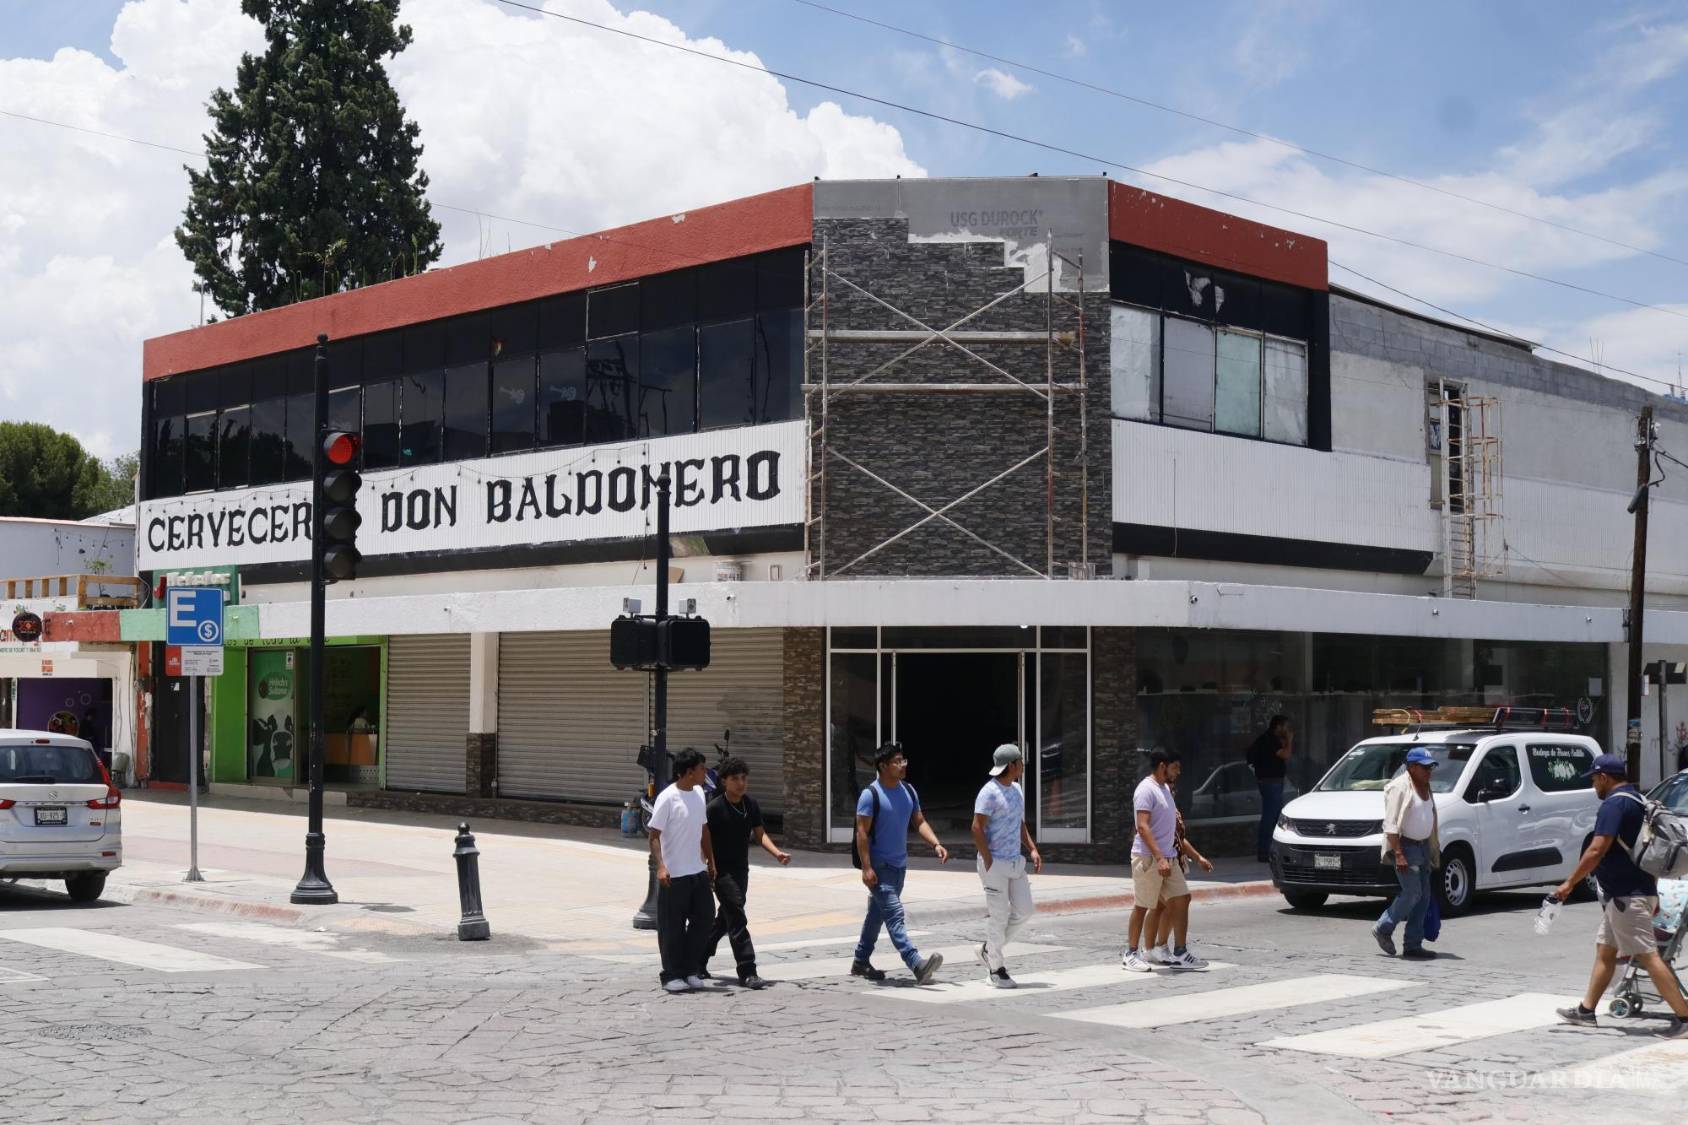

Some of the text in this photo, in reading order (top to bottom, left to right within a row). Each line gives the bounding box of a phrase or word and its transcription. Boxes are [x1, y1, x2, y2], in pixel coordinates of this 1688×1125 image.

[950, 211, 977, 227] USG
[147, 501, 313, 552] CERVECER
[380, 484, 458, 533] DON
[170, 591, 197, 627] E
